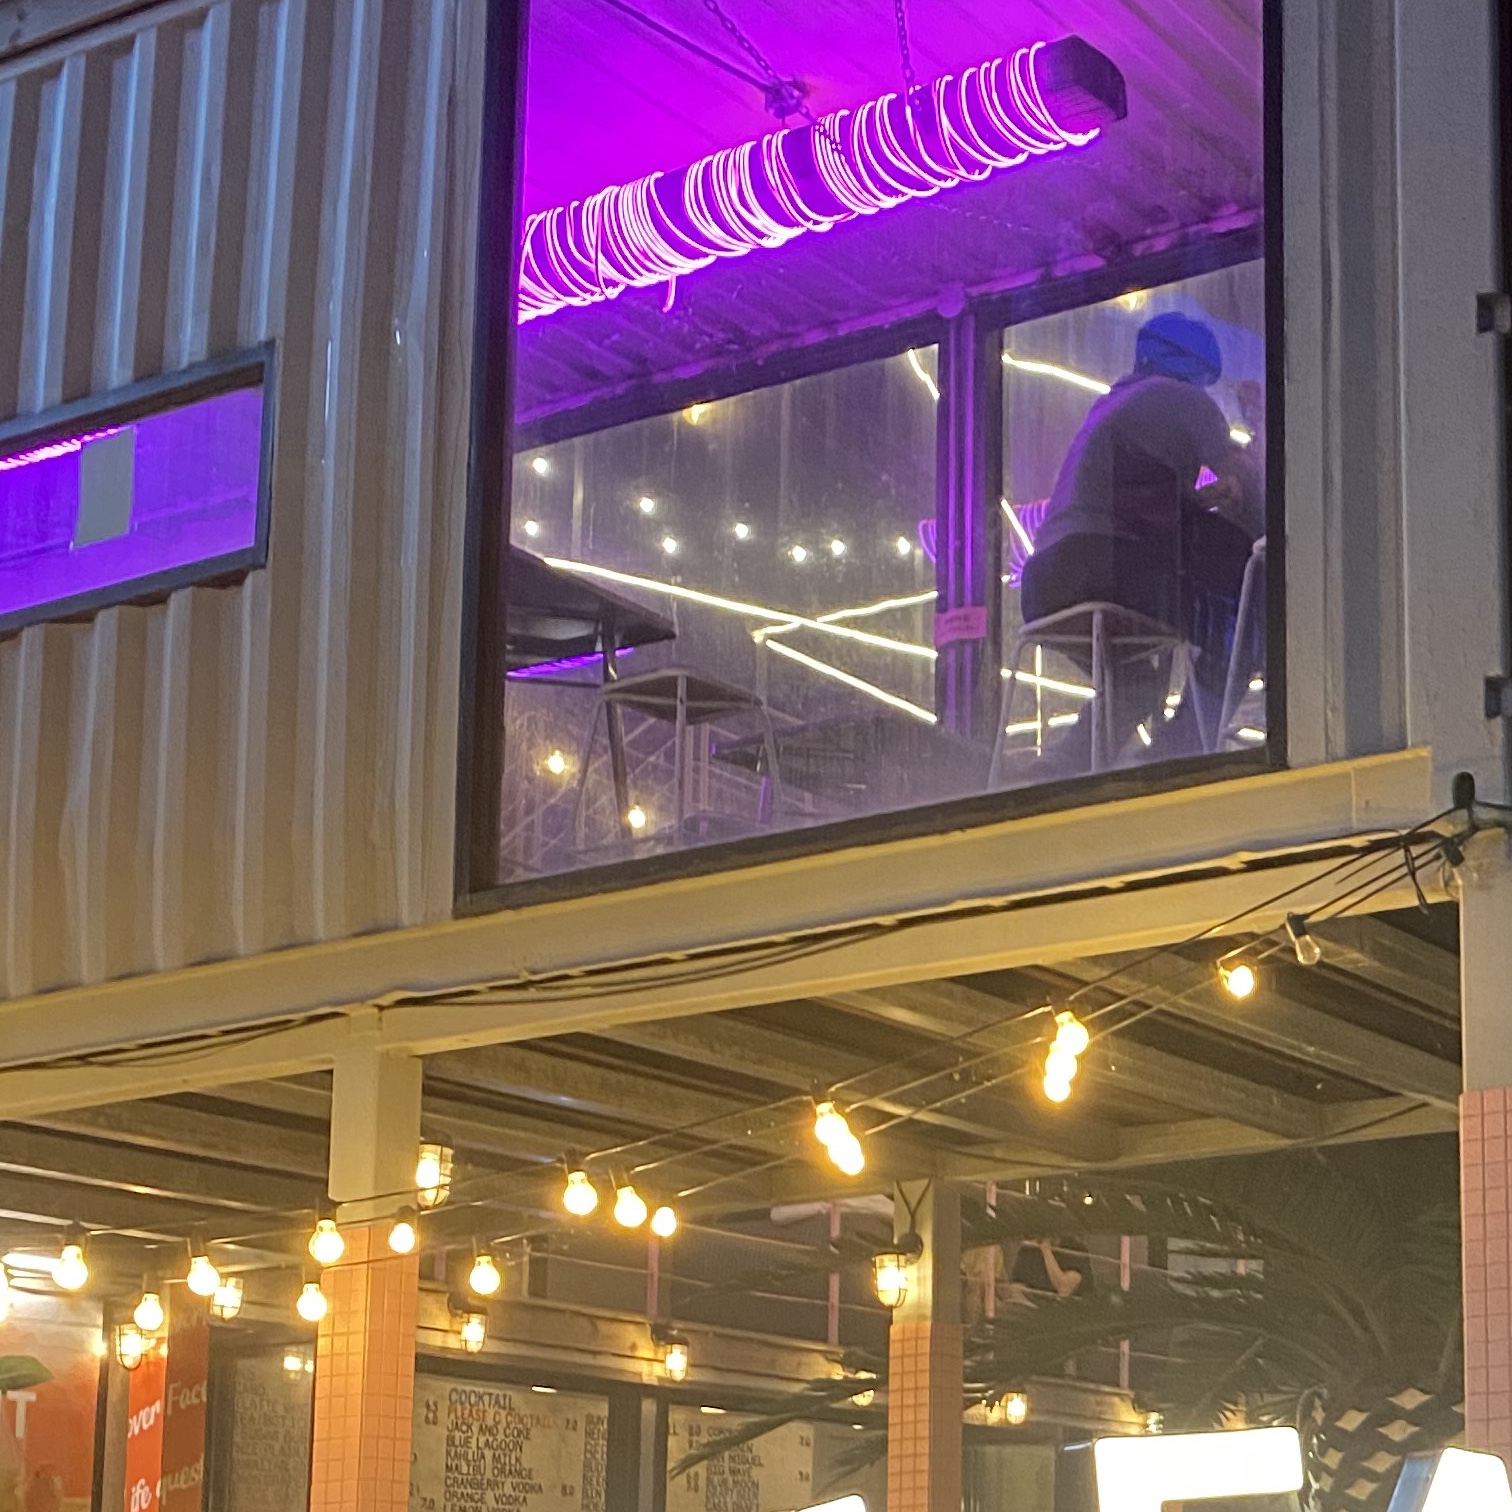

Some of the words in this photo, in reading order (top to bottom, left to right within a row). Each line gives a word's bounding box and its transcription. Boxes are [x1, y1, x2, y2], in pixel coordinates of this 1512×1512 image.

[449, 1387, 515, 1411] COCKTAIL
[6, 1390, 37, 1438] T
[448, 1406, 488, 1423] PLEASE
[447, 1420, 473, 1435] JACK
[478, 1423, 499, 1437] AND
[503, 1426, 532, 1441] COKE
[446, 1434, 472, 1450] BLUE
[476, 1437, 524, 1453] LAGOON
[446, 1449, 486, 1465] KAHLUA
[492, 1452, 523, 1467] MILK
[445, 1462, 486, 1477] MALIBU
[492, 1466, 534, 1481] ORANGE
[444, 1475, 506, 1492] CRANBERRY
[511, 1481, 543, 1495] VODKA
[444, 1490, 487, 1505] ORANGE
[494, 1494, 528, 1507] VODKA
